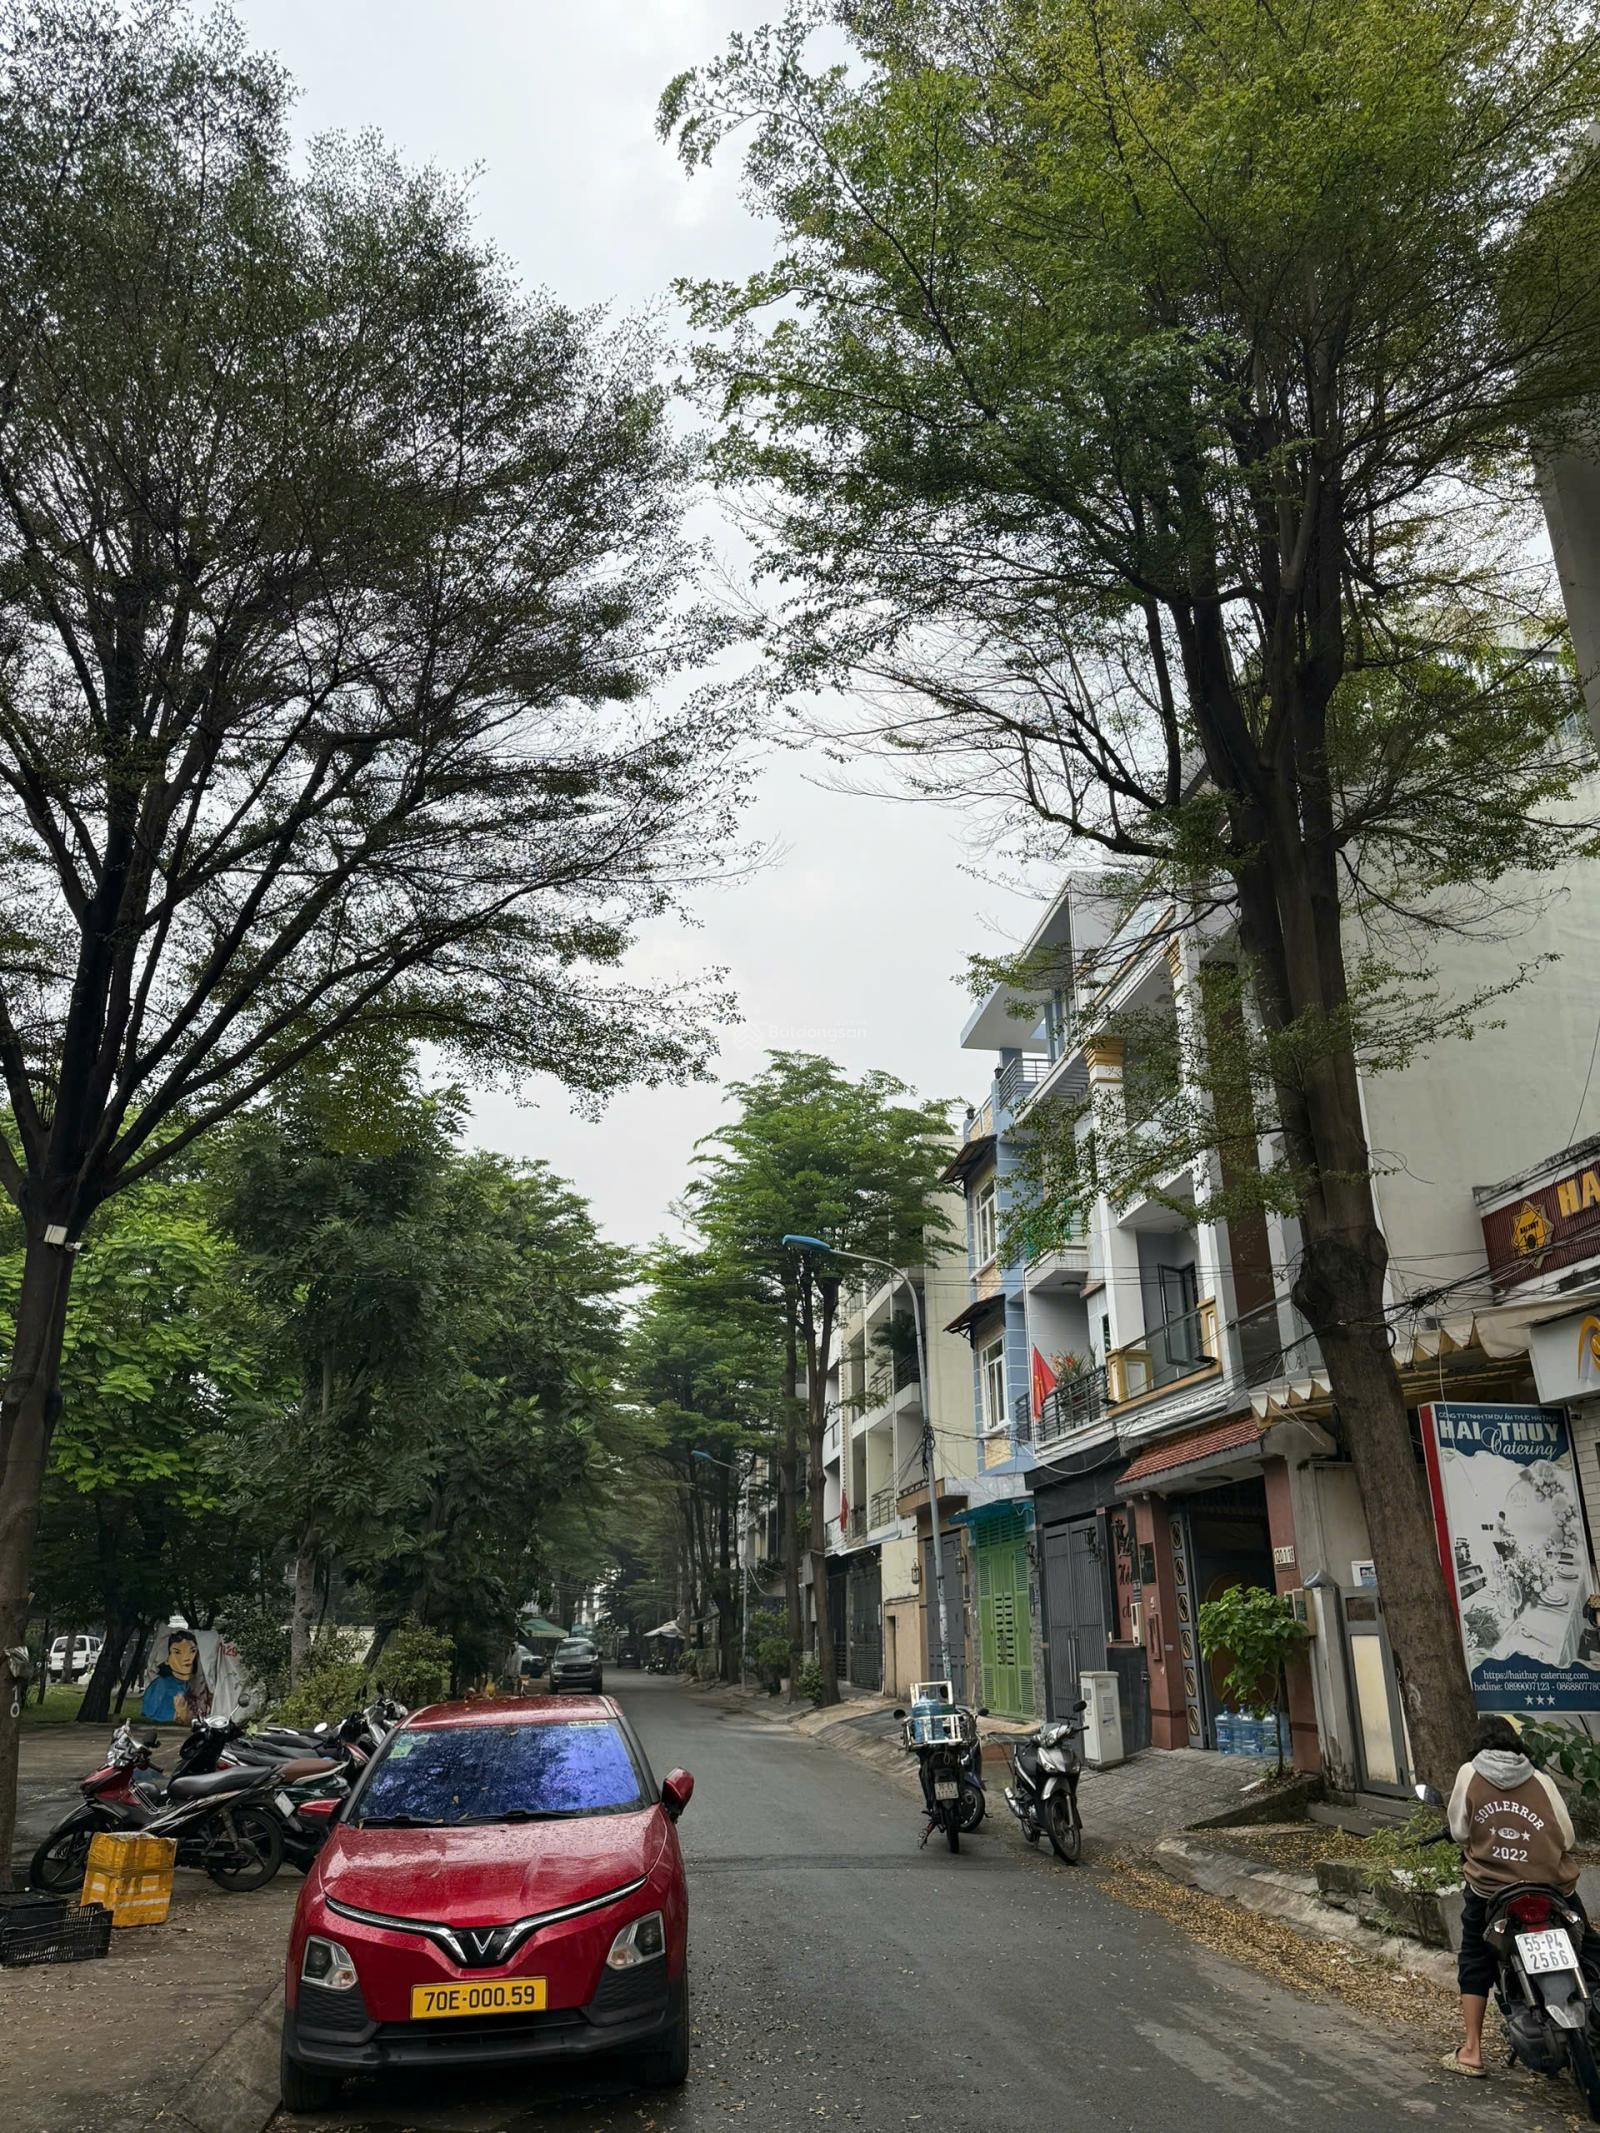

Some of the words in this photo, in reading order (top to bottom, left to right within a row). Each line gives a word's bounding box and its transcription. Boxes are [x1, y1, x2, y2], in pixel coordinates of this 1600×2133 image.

[1440, 1420, 1481, 1440] HAI
[1497, 1422, 1559, 1442] THUY
[1481, 1427, 1557, 1459] Catering
[1474, 1800, 1545, 1831] SOULERROR
[1492, 1846, 1529, 1863] 2022
[1523, 1933, 1563, 1952] 55-P4
[1530, 1950, 1569, 1970] 2566
[424, 1985, 535, 2012] 70E-000.59
